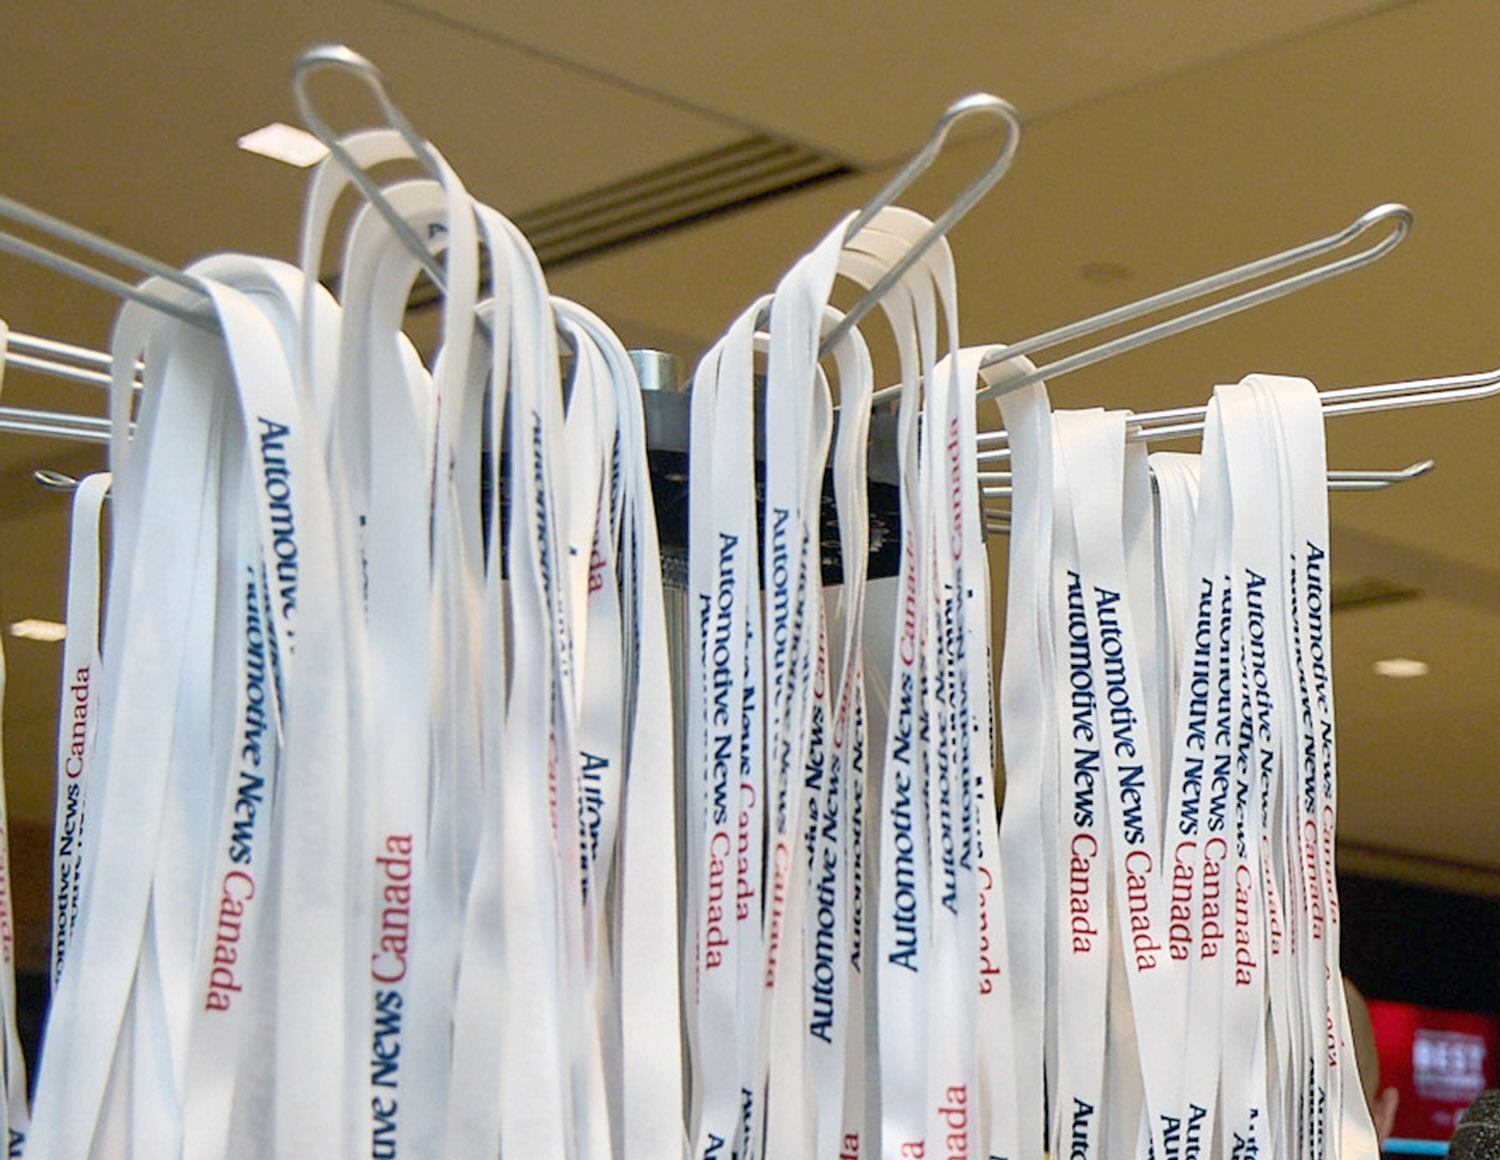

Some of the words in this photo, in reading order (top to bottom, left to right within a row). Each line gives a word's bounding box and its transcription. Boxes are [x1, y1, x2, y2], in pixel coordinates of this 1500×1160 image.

[239, 566, 269, 768] tomotive
[713, 533, 738, 726] Automotive
[1094, 586, 1138, 758] Automotive
[1214, 575, 1232, 747] utomotive
[1245, 568, 1274, 743] Automotive
[1307, 540, 1328, 714] Automotive
[1320, 720, 1333, 799] News
[66, 666, 90, 778] Canada
[804, 705, 825, 789] News
[893, 672, 914, 764] News
[1304, 734, 1315, 815] News
[60, 783, 80, 856] News
[228, 770, 265, 865] News
[713, 734, 732, 825] News
[821, 754, 842, 844] News
[1073, 747, 1100, 828] News
[1117, 765, 1146, 845] News
[1179, 757, 1204, 835] News
[1208, 755, 1232, 832] News
[1235, 779, 1249, 859] News
[371, 834, 413, 984] Canada
[706, 831, 731, 969] Canada
[735, 783, 755, 921] Canada
[888, 770, 919, 973] Automotive
[1070, 833, 1098, 954] Canada
[1124, 850, 1162, 972] Canada
[1168, 841, 1198, 962] Canada
[1200, 836, 1228, 960] Canada
[1303, 819, 1324, 940] Canada
[205, 870, 255, 1012] Canada
[809, 847, 837, 1044] Automotive
[1234, 864, 1257, 986] Canada
[371, 989, 404, 1088] News
